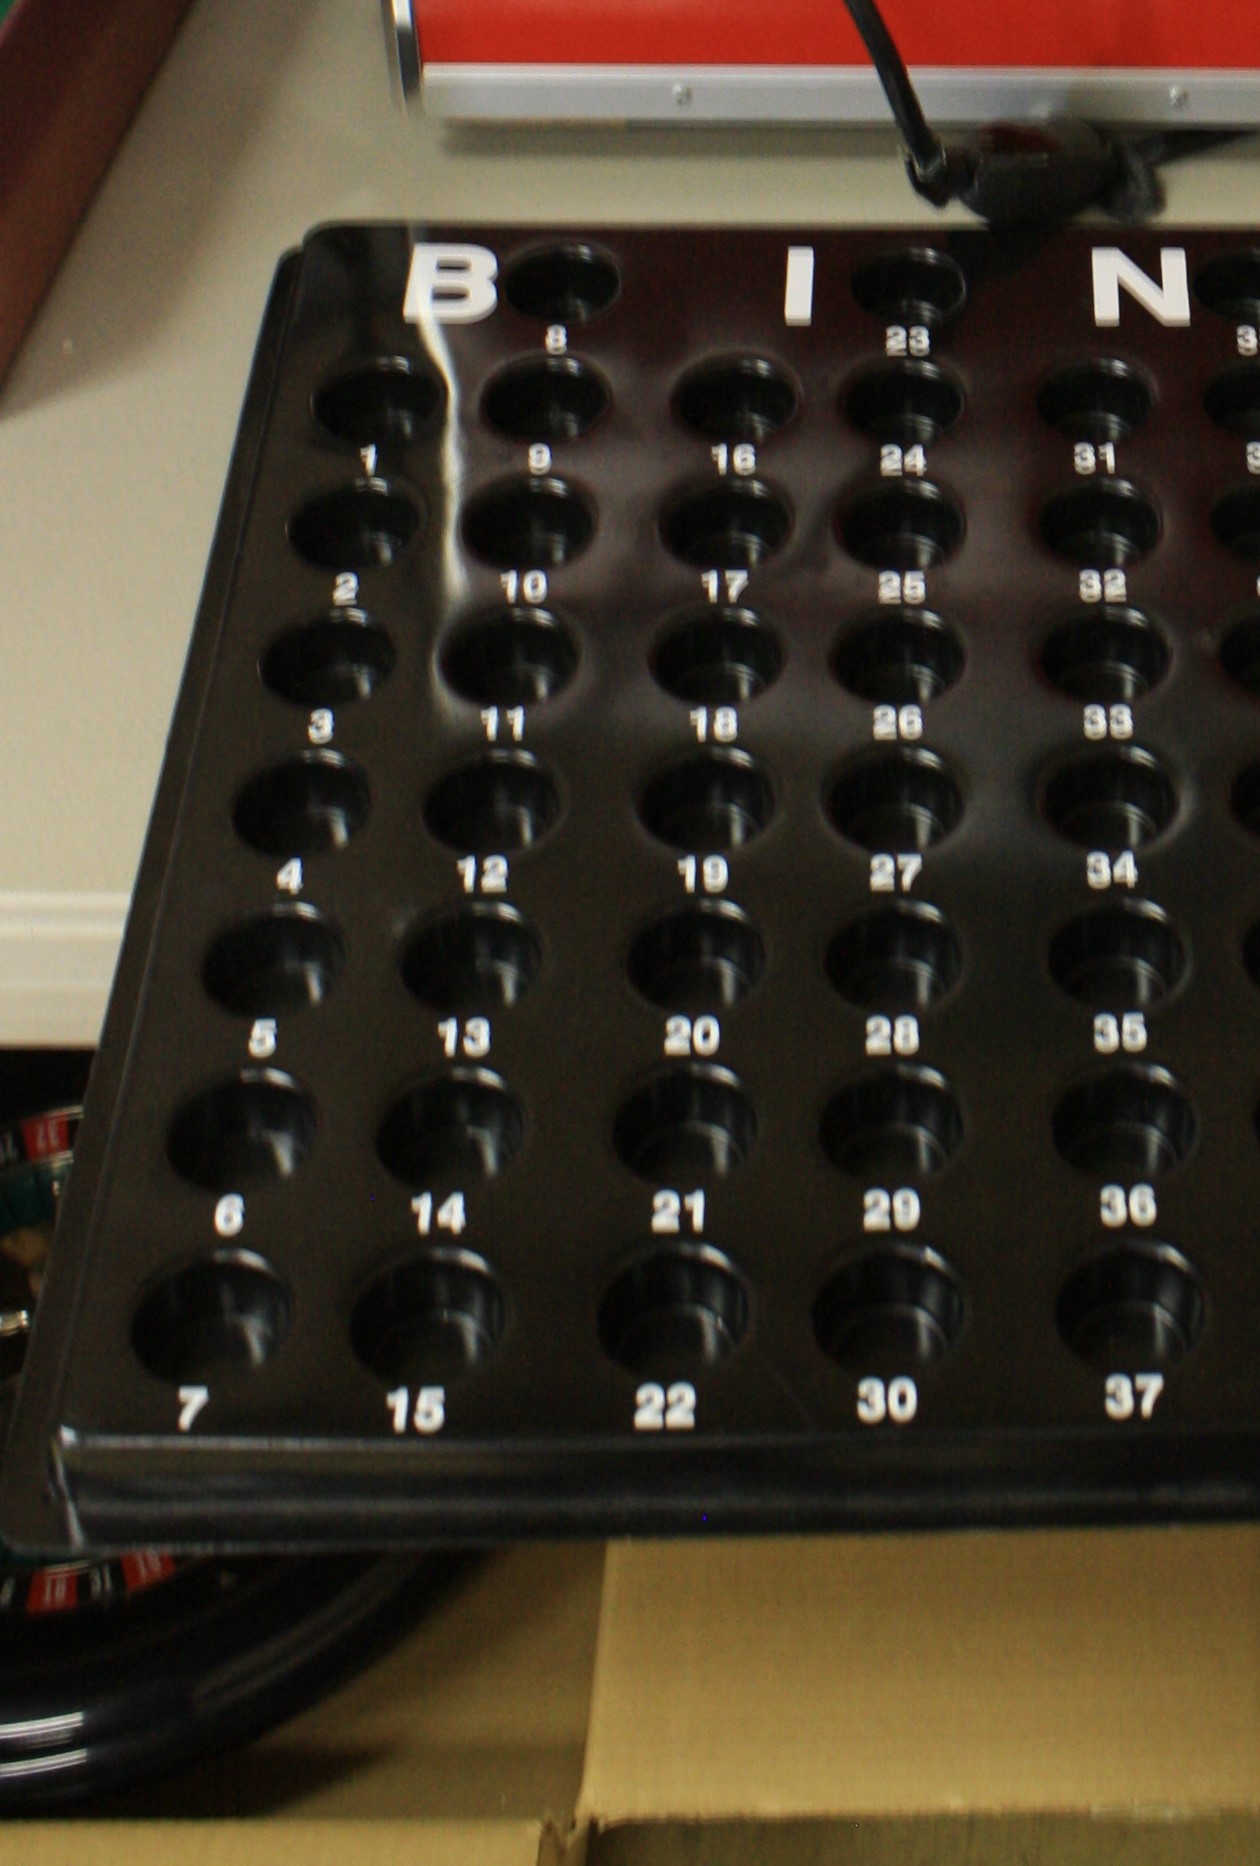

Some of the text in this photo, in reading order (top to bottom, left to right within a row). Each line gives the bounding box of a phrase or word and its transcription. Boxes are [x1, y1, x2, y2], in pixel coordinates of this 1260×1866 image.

[402, 244, 499, 323] B
[783, 246, 816, 324] I
[1090, 246, 1192, 324] N
[545, 325, 567, 355] 8
[886, 326, 930, 355] 23
[361, 445, 376, 474] 1
[712, 443, 756, 475] 16
[880, 444, 927, 475] 24
[1074, 442, 1116, 474] 31
[333, 572, 358, 605] 2
[500, 570, 548, 603] 10
[701, 570, 748, 602] 17
[878, 570, 926, 604] 25
[1079, 569, 1127, 601] 32
[308, 709, 333, 743] 3
[480, 706, 524, 740] 11
[689, 706, 738, 741] 18
[872, 705, 923, 739] 26
[1083, 704, 1134, 738] 33
[276, 858, 303, 894] 4
[457, 855, 508, 892] 12
[870, 854, 923, 890] 27
[1086, 851, 1138, 887] 34
[248, 1019, 277, 1057] 5
[438, 1017, 490, 1056] 13
[664, 1016, 720, 1054] 20
[865, 1015, 920, 1053] 28
[1094, 1013, 1148, 1052] 35
[214, 1194, 244, 1235] 6
[411, 1193, 466, 1233] 14
[651, 1190, 705, 1231] 21
[179, 1387, 209, 1430] 7
[387, 1387, 445, 1431] 15
[634, 1382, 696, 1428] 22
[857, 1377, 918, 1421] 30
[1105, 1374, 1164, 1417] 37
